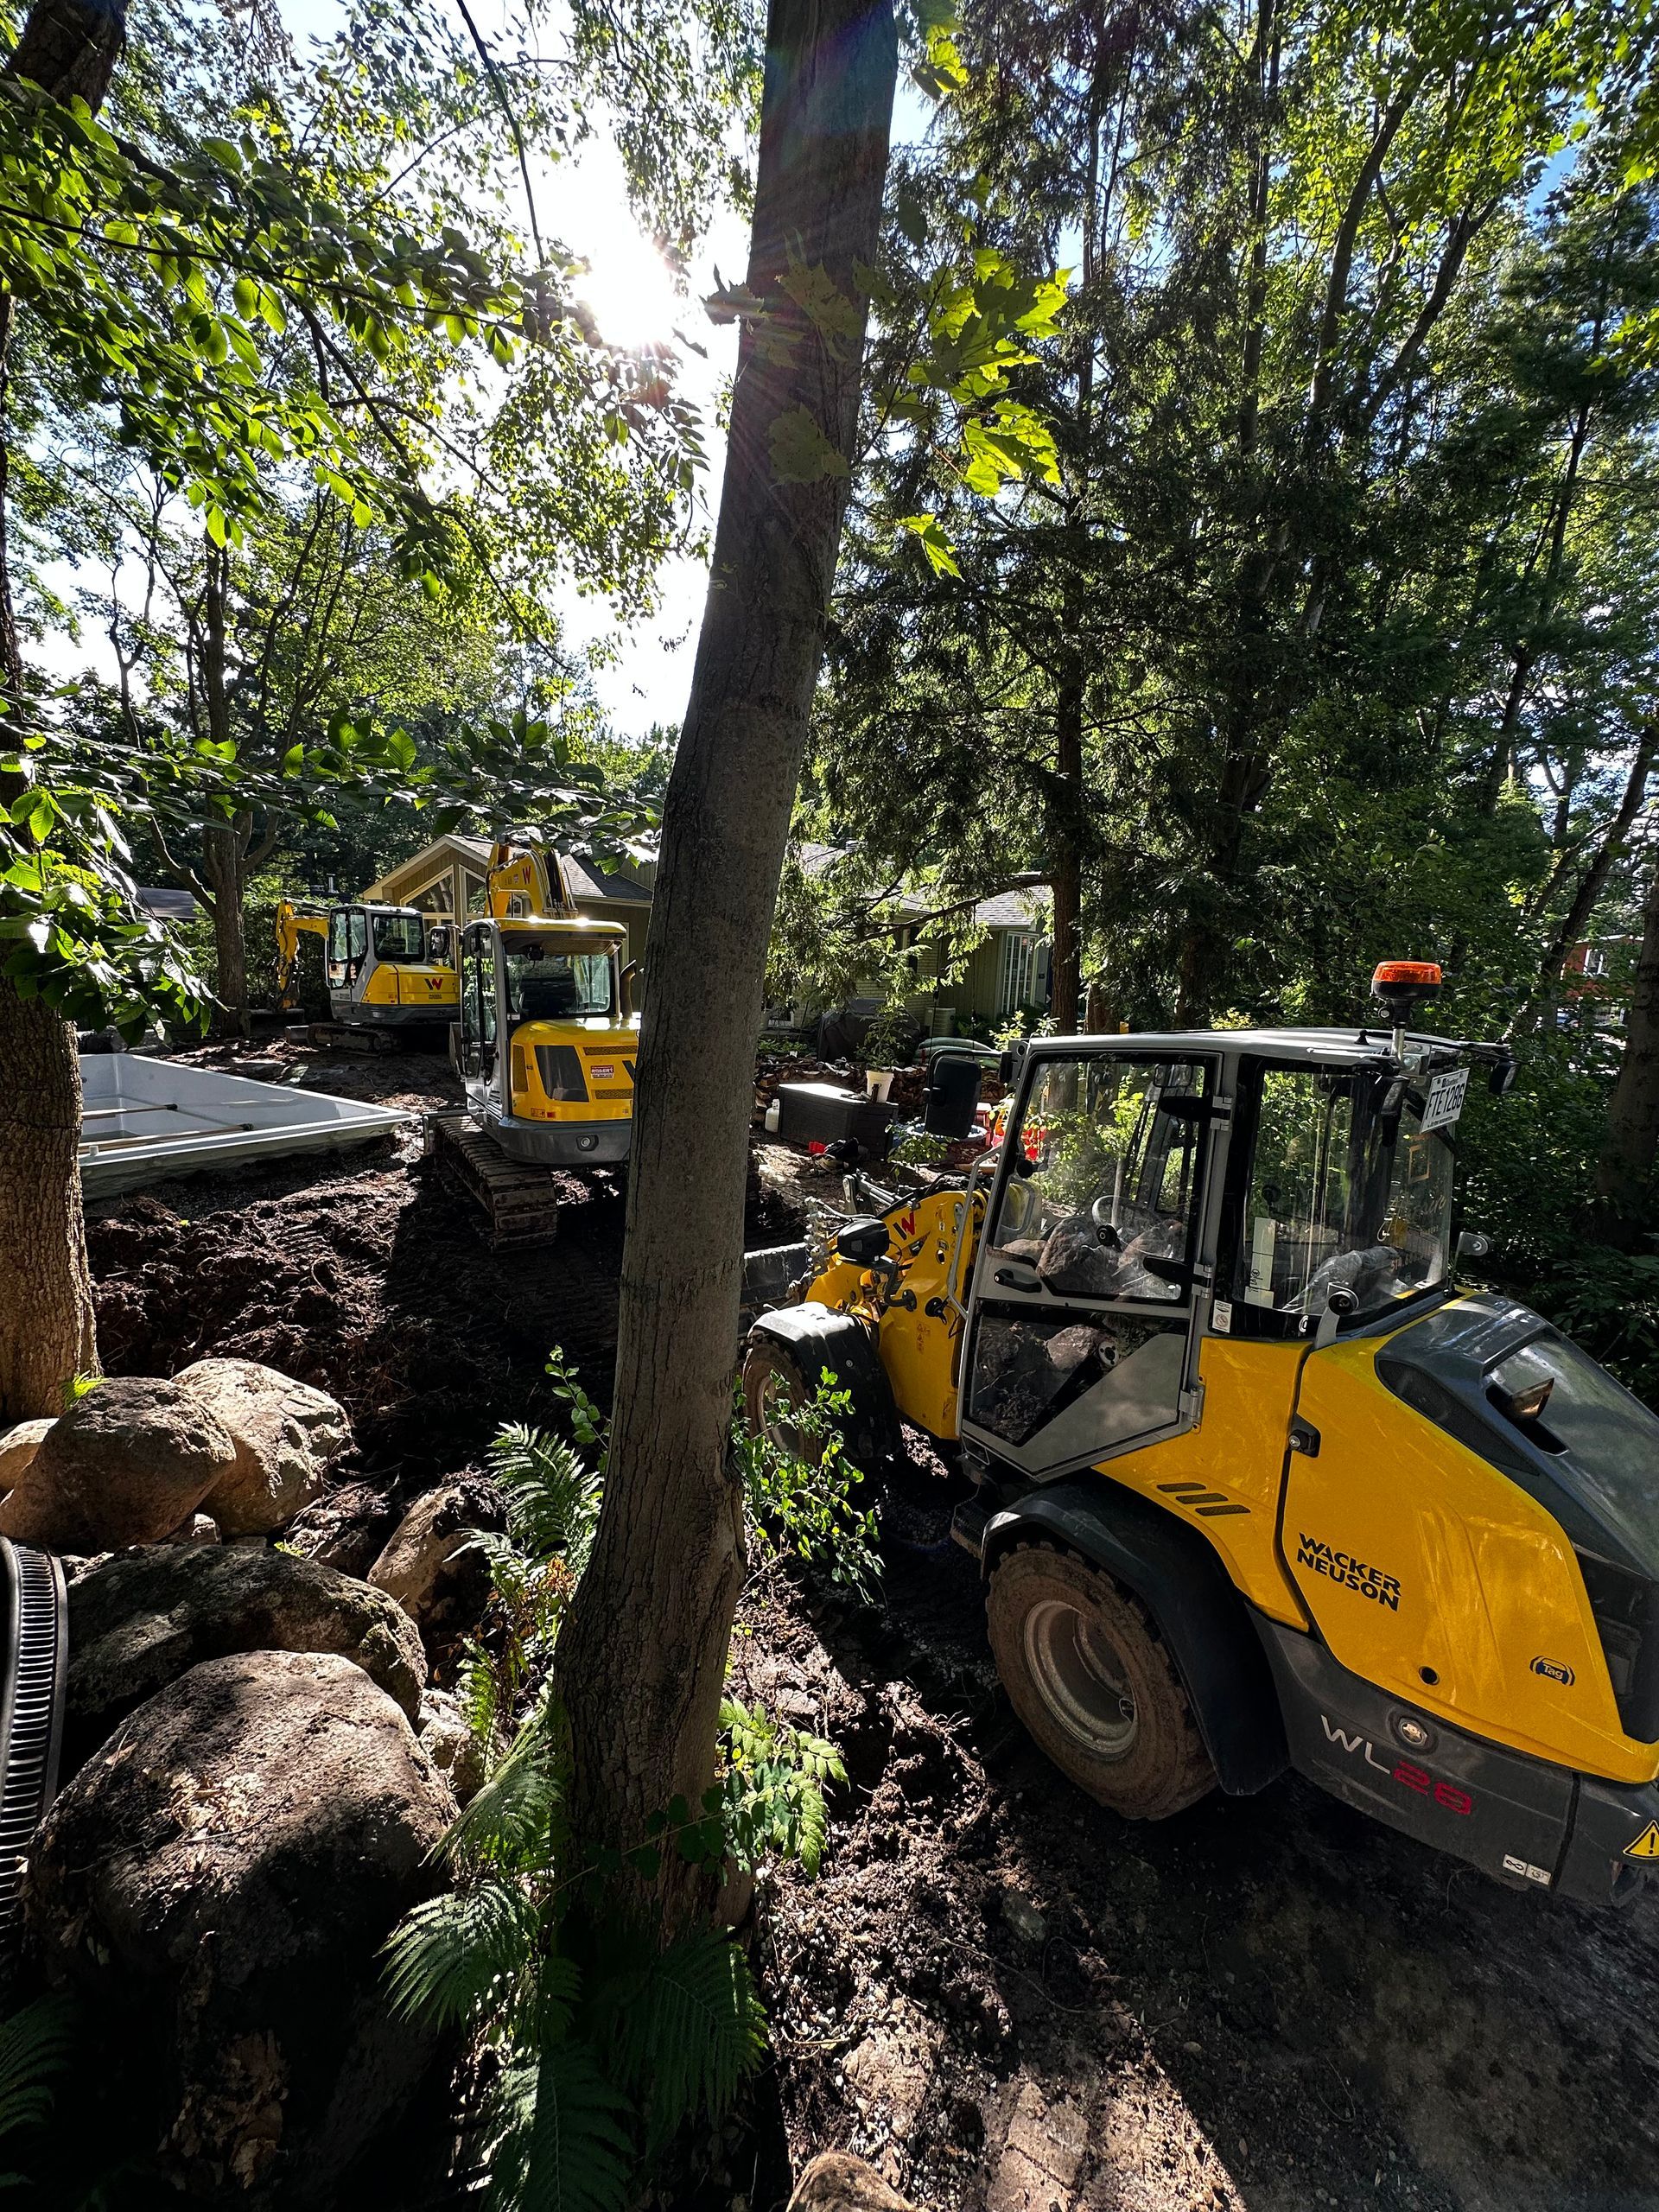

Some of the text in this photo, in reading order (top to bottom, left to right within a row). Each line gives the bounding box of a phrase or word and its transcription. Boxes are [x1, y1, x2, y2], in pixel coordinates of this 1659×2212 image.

[1426, 1083, 1465, 1120] FTE1286
[1297, 1548, 1400, 1612] NEUSON
[1299, 1531, 1402, 1597] WACKER
[1542, 1663, 1564, 1680] Tag
[1321, 1714, 1472, 1815] WL28
